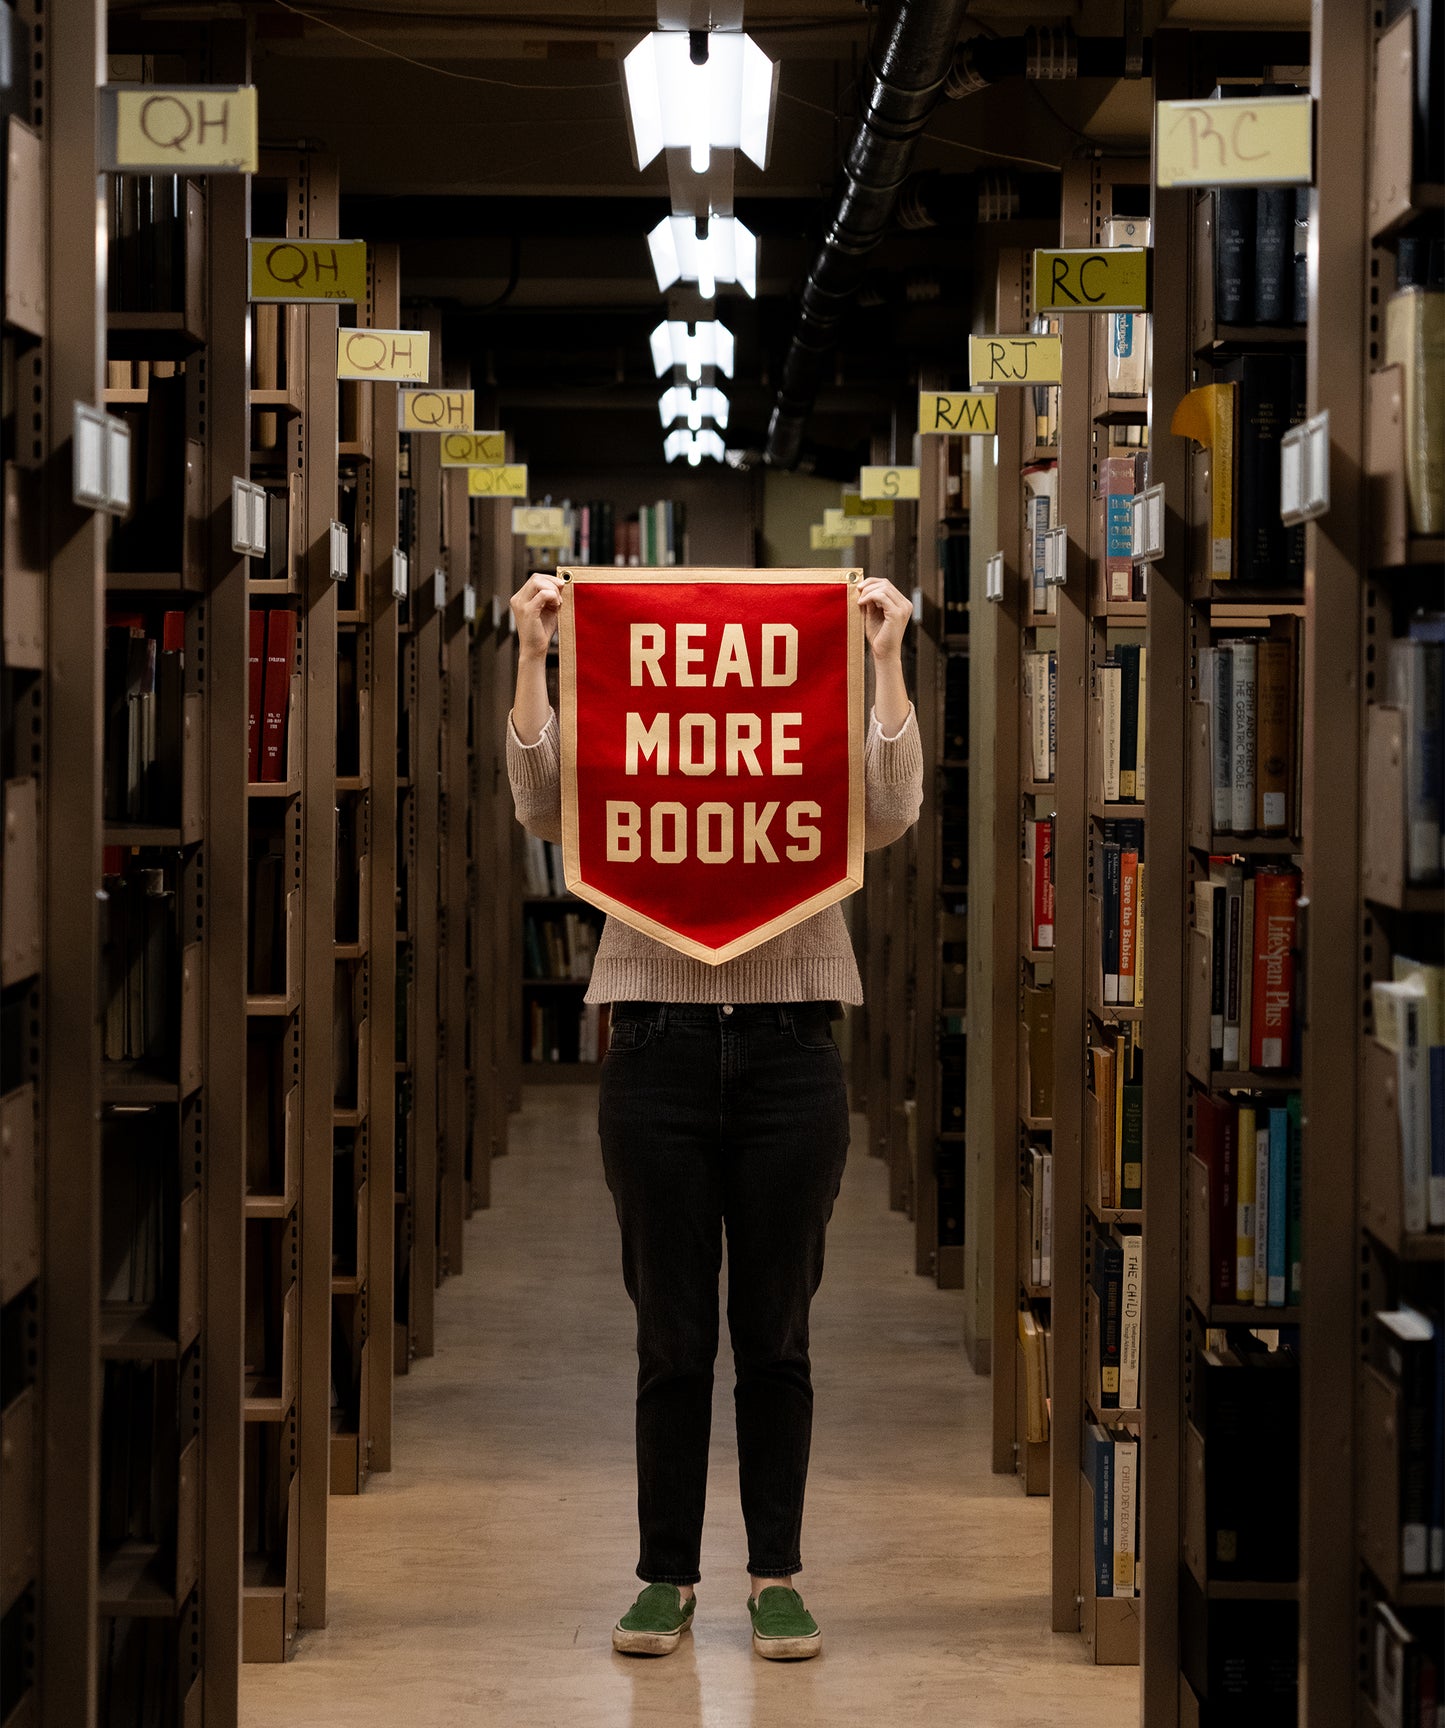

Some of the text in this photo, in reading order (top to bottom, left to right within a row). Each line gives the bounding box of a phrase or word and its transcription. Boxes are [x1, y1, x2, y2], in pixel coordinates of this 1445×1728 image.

[140, 95, 229, 152] QH
[1168, 107, 1271, 170] RC
[266, 244, 338, 288] QH
[1051, 256, 1109, 304] RC
[346, 332, 412, 371] QH
[1118, 313, 1128, 354] yclopedia
[987, 340, 1038, 380] RJ
[412, 392, 465, 427] QH
[934, 396, 990, 430] RM
[444, 434, 492, 462] QK
[472, 468, 512, 492] QK
[882, 471, 900, 498] S
[1114, 512, 1130, 522] and
[630, 623, 799, 687] READ
[1246, 680, 1255, 712] DEPTH
[626, 712, 803, 776] MORE
[1236, 680, 1245, 789] THE GERIATRIC PROBLE
[1246, 715, 1255, 738] AND
[1246, 742, 1255, 778] EXTENT
[606, 800, 822, 864] BOOKS
[1122, 876, 1134, 969] Save the Babies
[1259, 916, 1294, 1026] LifeSpan Plus
[1127, 1256, 1138, 1278] THE
[1121, 1465, 1130, 1493] CHILD
[1120, 1494, 1130, 1558] DEVELOPMENT
